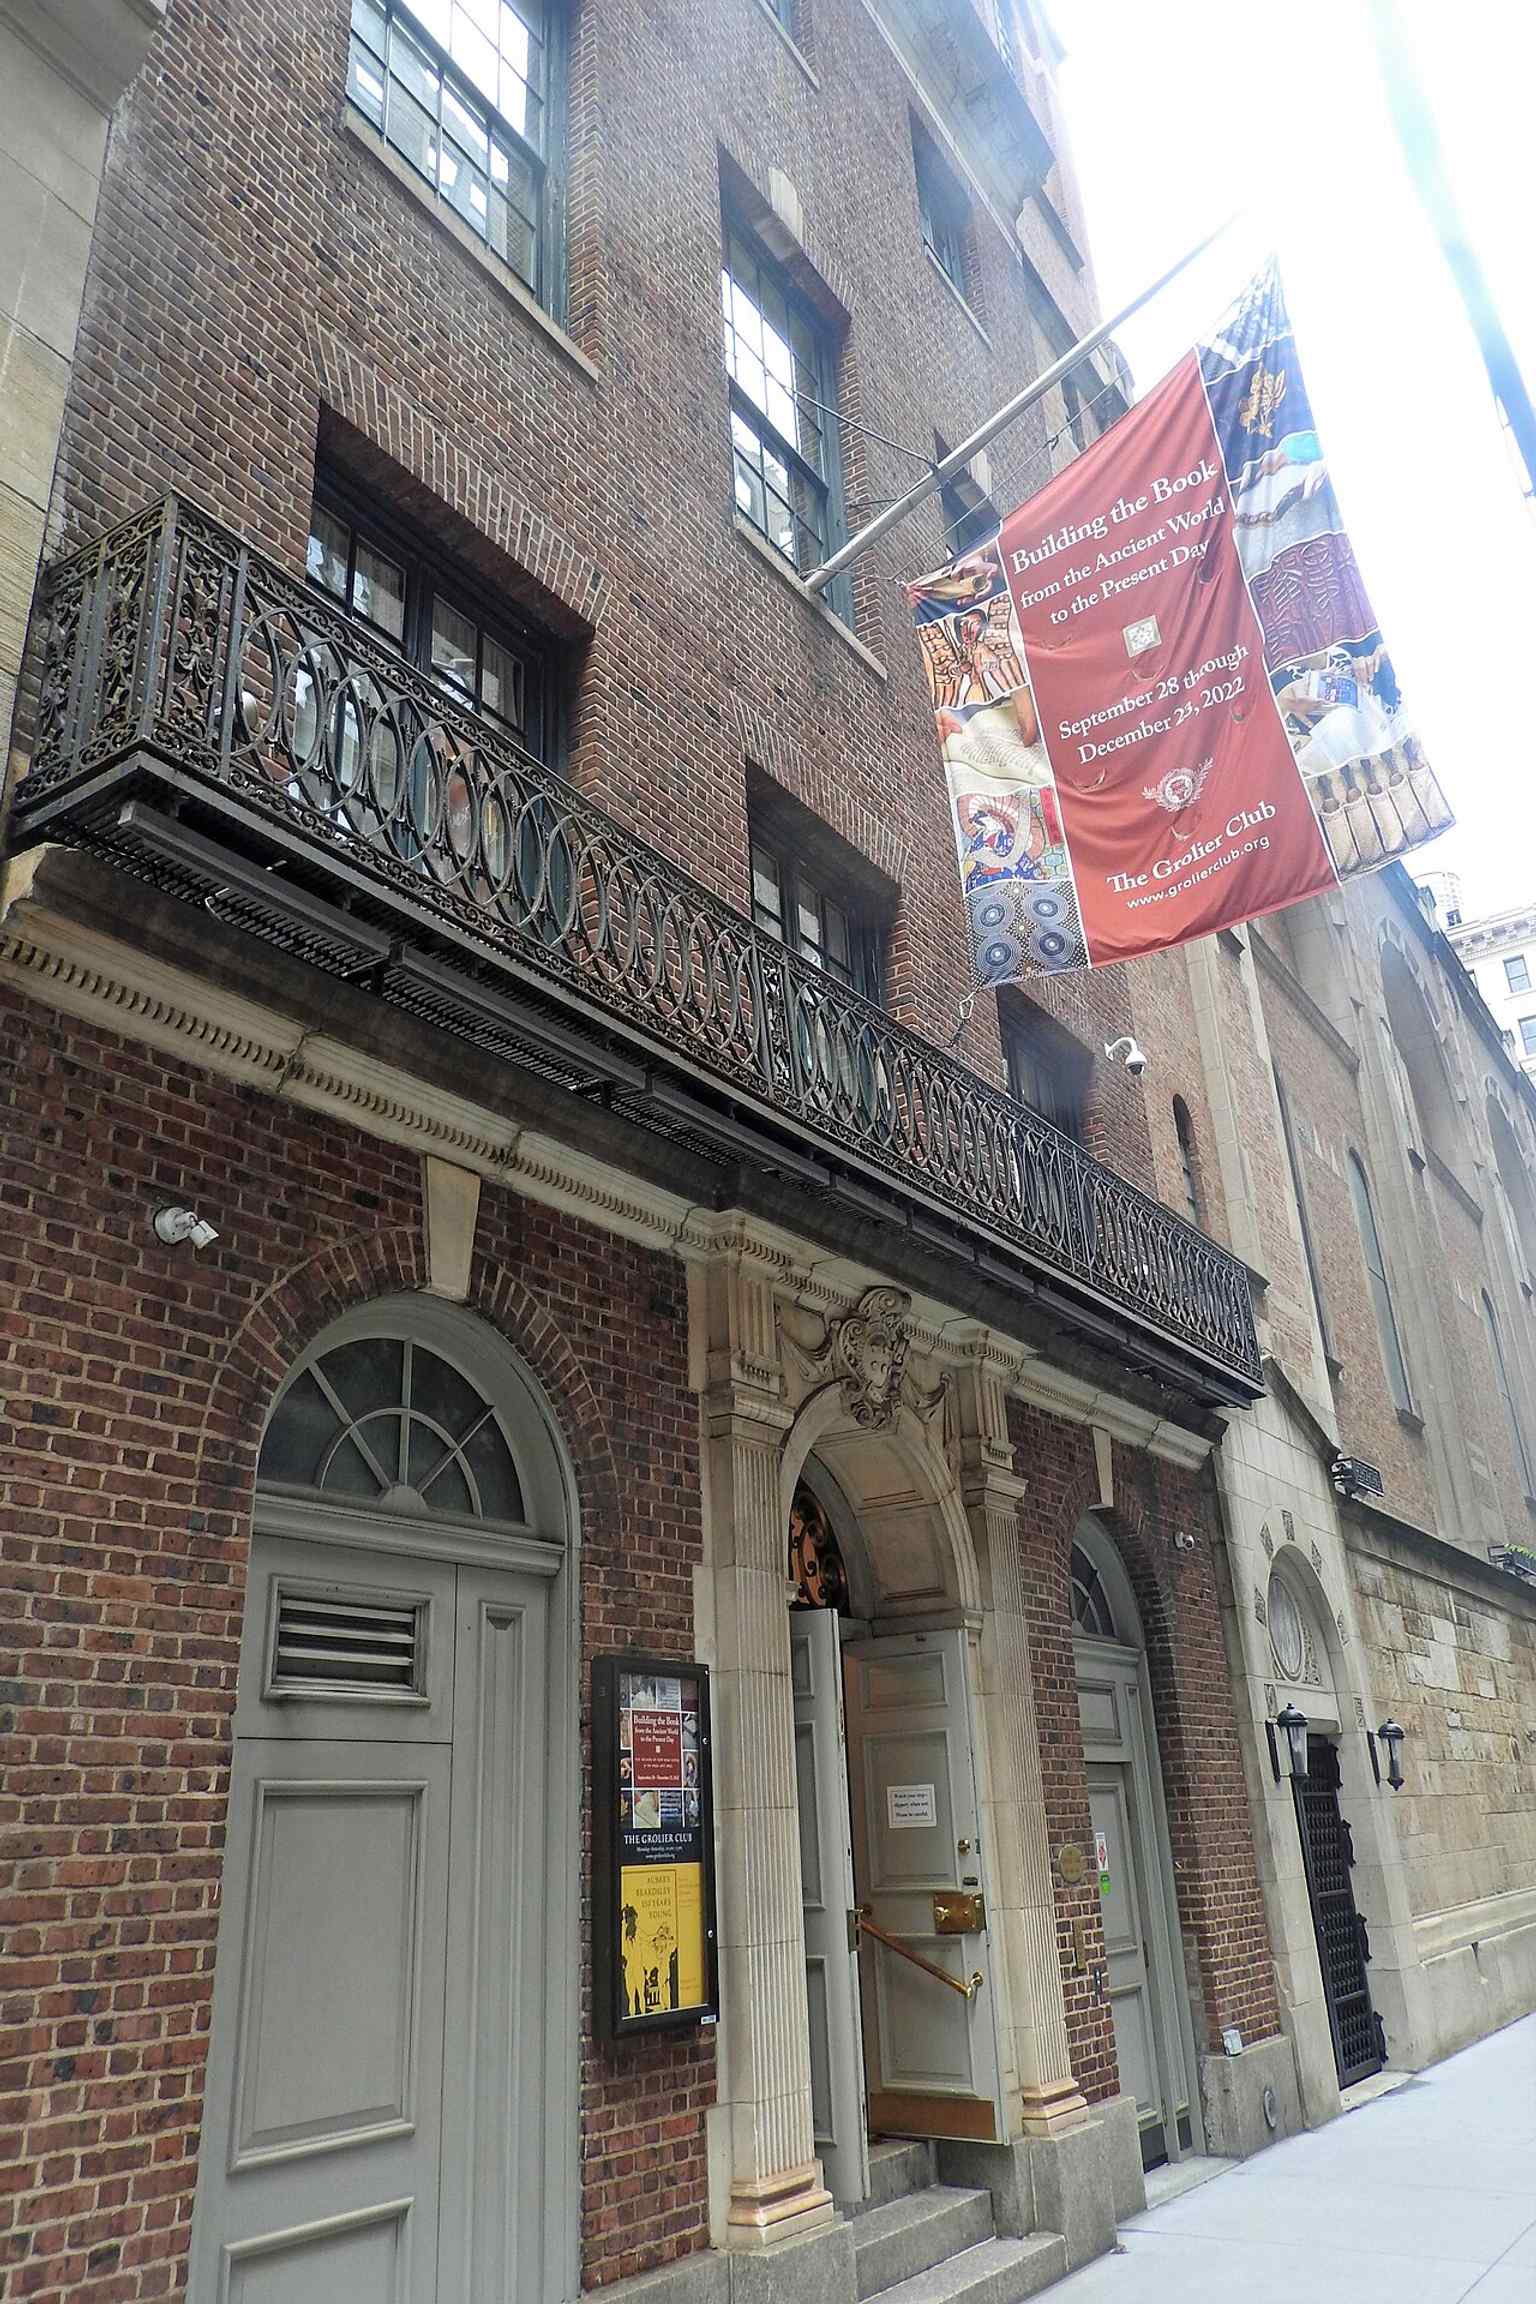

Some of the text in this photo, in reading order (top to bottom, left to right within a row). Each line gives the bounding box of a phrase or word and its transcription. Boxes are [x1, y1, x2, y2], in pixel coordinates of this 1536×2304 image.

[1010, 459, 1218, 575] Building the Book
[1020, 497, 1225, 609] from the Ancient World
[1050, 540, 1210, 624] to the Present Day
[1058, 644, 1249, 740] September 28 through
[1077, 715, 1172, 764] December
[1174, 700, 1200, 726] 23,
[1200, 676, 1245, 707] 2022
[1107, 800, 1277, 894] The Grolier Club
[1127, 835, 1270, 910] www.grolierclub.org
[624, 1832, 692, 1845] THE GROLIER CLUB
